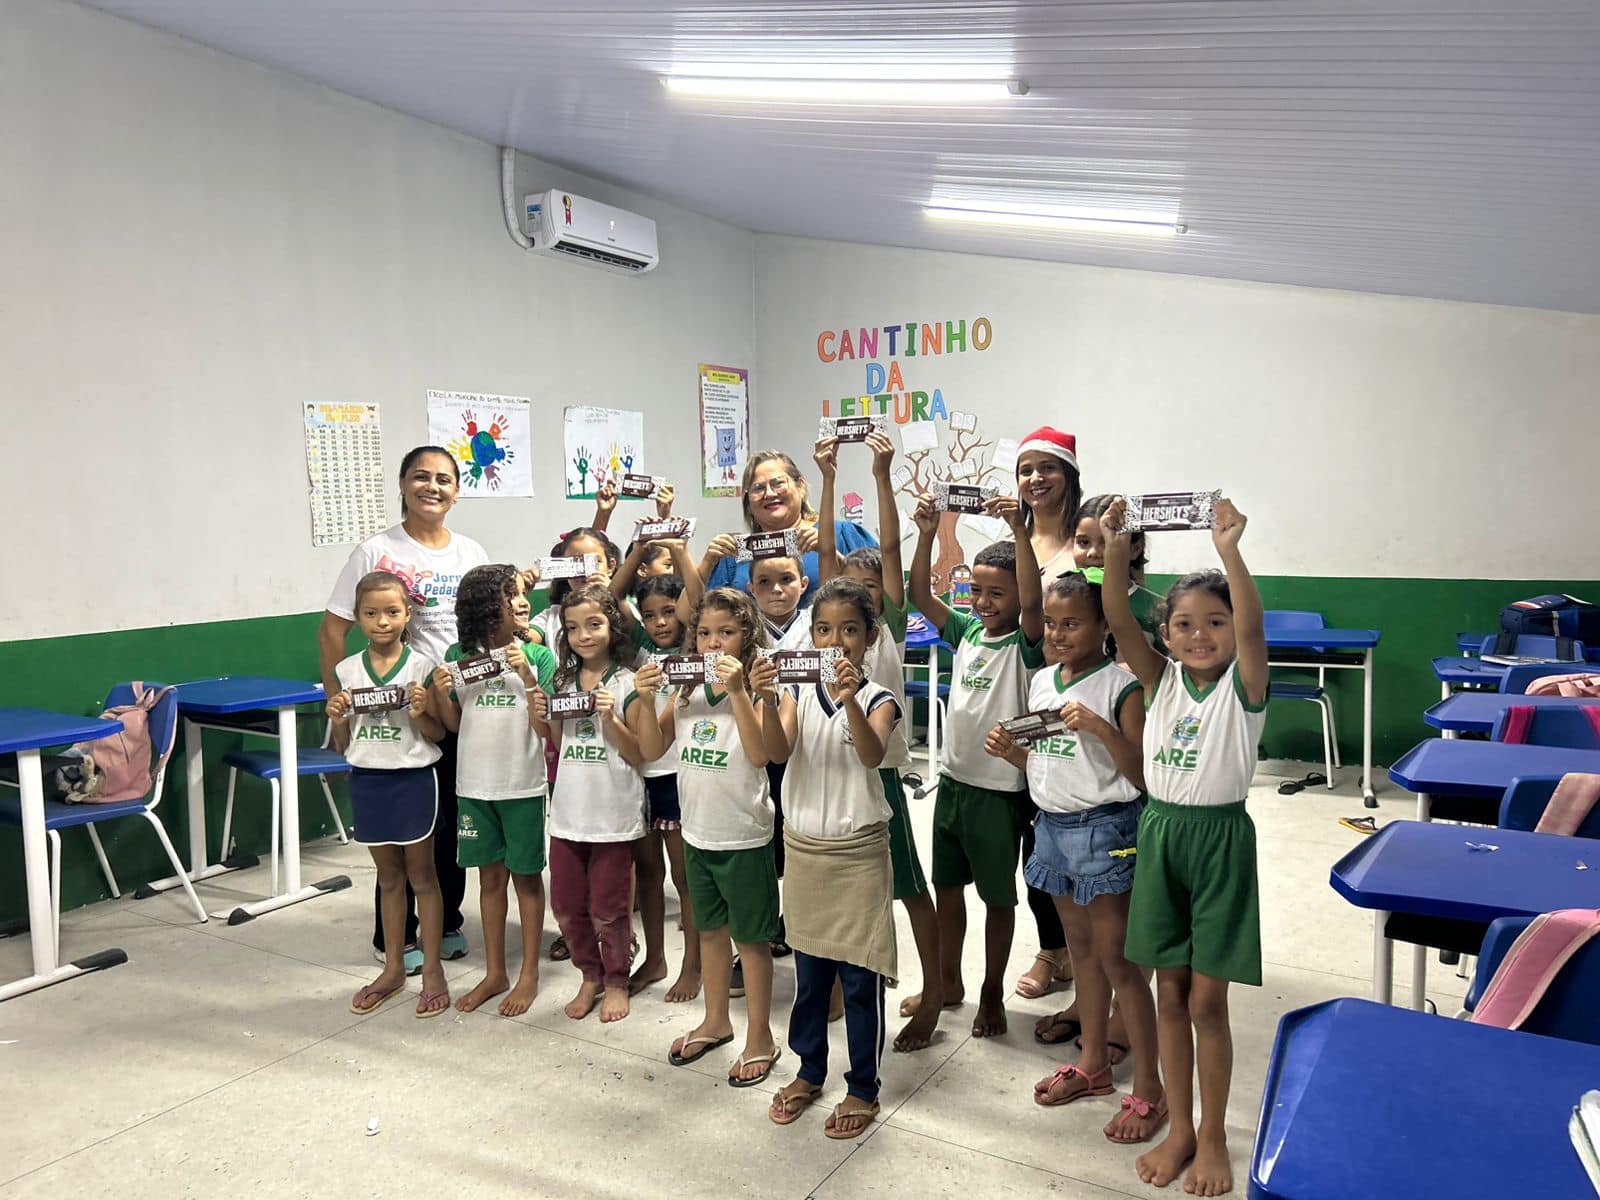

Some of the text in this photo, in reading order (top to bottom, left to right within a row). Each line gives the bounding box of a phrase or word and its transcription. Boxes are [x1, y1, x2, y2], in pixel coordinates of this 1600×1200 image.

[817, 317, 993, 363] CANTINHO
[866, 361, 904, 395] DA
[836, 424, 868, 436] HERSHEY'S
[949, 494, 978, 508] HERSHEY'S
[1143, 506, 1190, 521] HERSHEY'S
[641, 521, 681, 534] HERSHEY'S
[752, 537, 785, 550] HERSHEY'S
[461, 662, 495, 680] HERSHEY'S
[669, 662, 704, 674] HERSHEY'S
[780, 658, 820, 671] HERSHEY'S
[961, 674, 993, 689] AREZ
[353, 690, 398, 707] HERSHEY'S
[475, 695, 517, 706] AREZ
[552, 696, 590, 713] HERSHEY'S
[356, 726, 402, 741] AREZ
[563, 745, 607, 761] AREZ
[1030, 737, 1077, 757] AREZ
[681, 746, 729, 767] AREZ
[1152, 745, 1199, 768] ARE
[458, 829, 479, 837] AREZ
